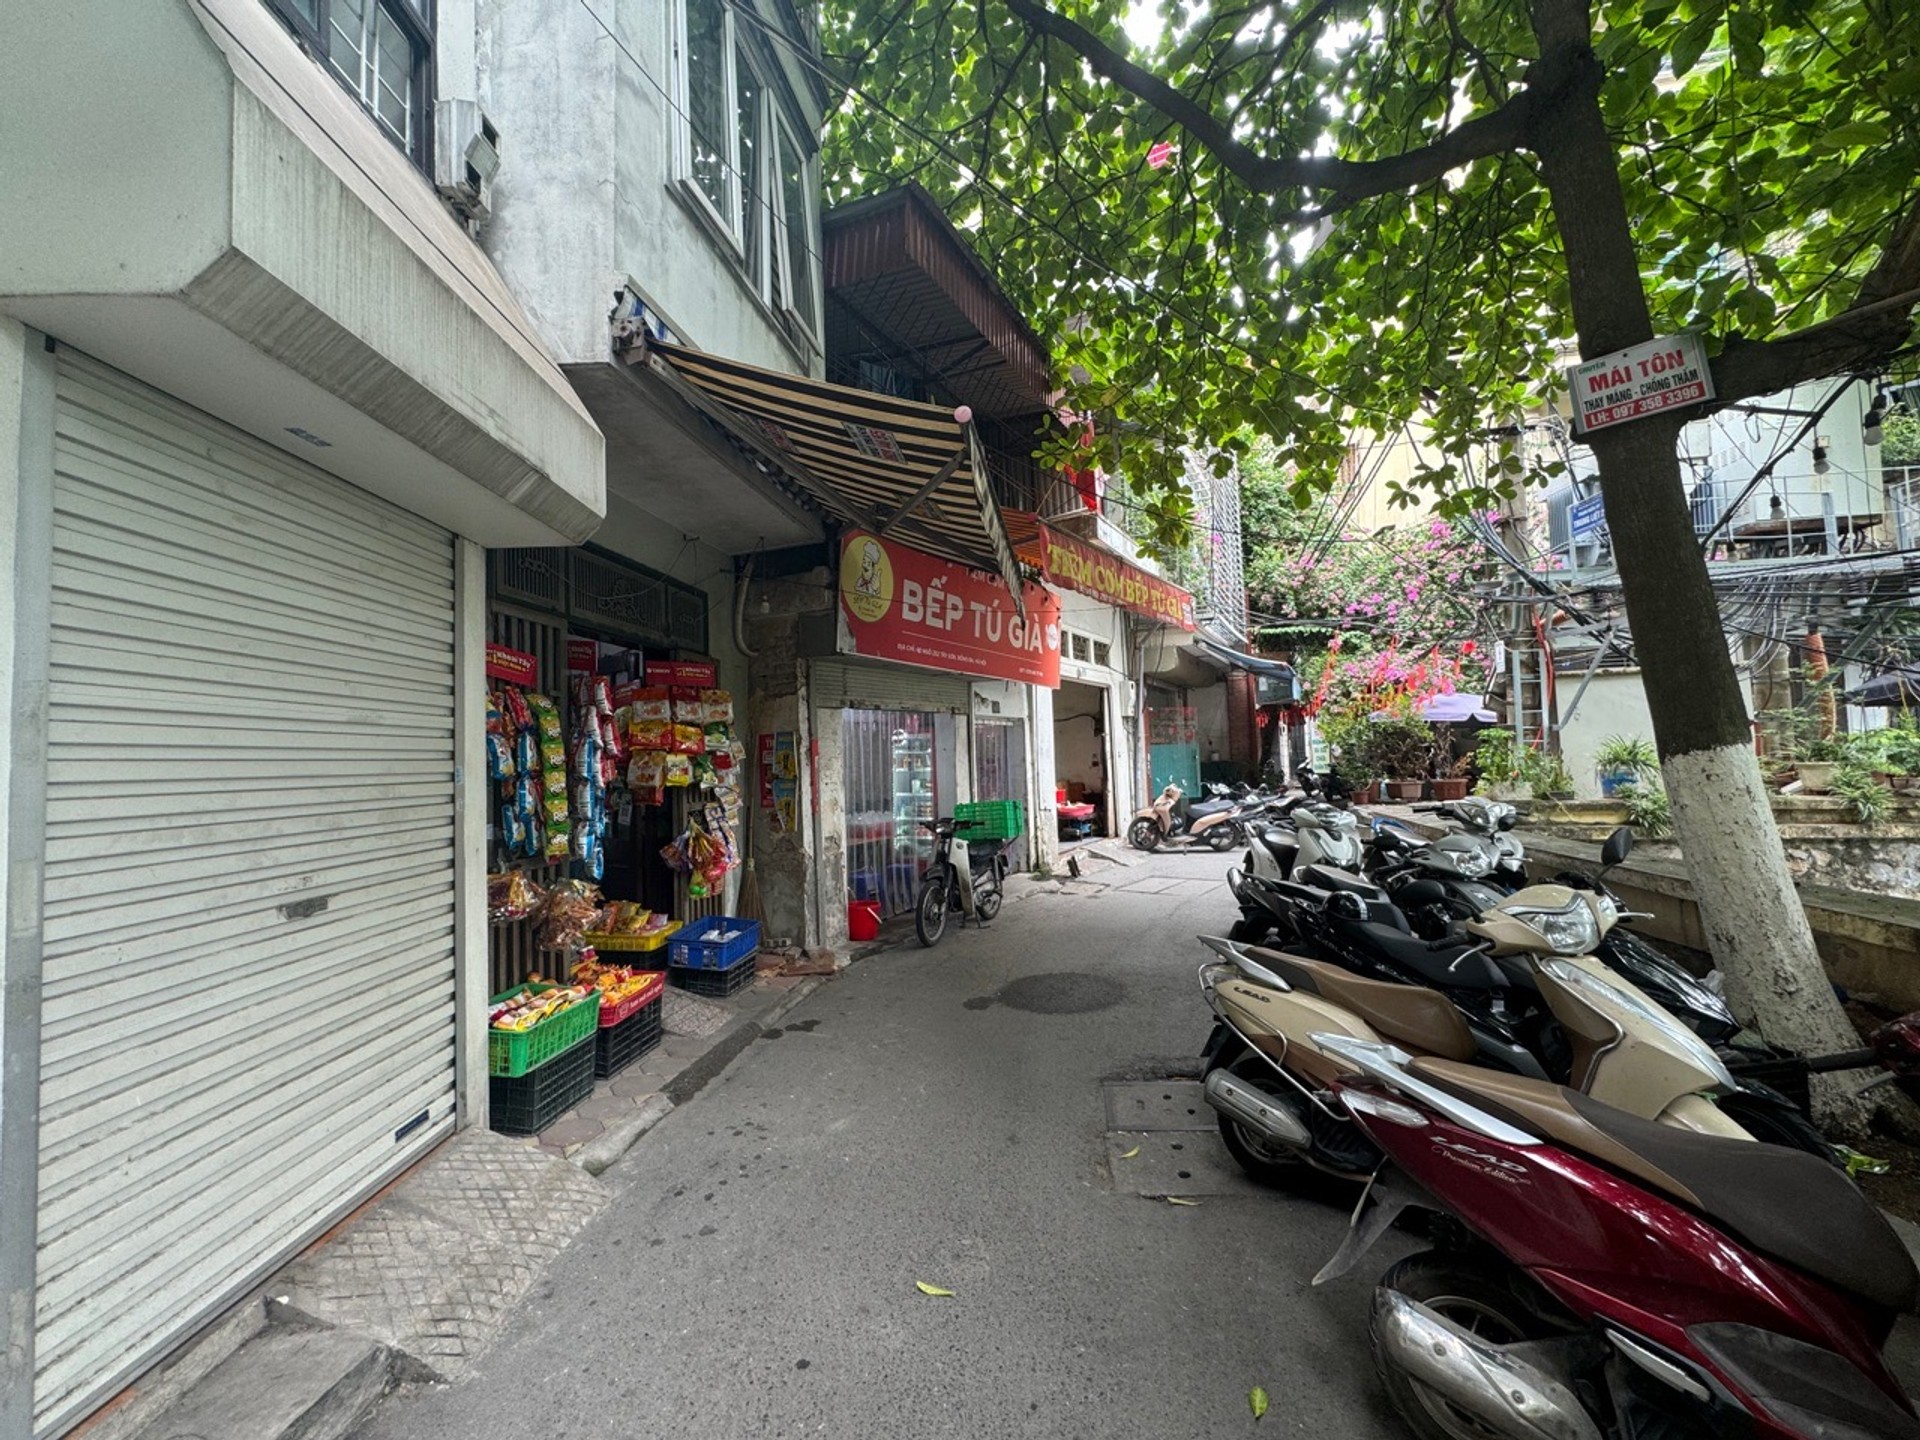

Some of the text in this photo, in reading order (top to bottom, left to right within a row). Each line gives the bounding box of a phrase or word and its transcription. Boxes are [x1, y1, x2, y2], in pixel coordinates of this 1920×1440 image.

[1584, 396, 1605, 412] THAY
[1606, 388, 1633, 406] MÁNG
[1639, 376, 1671, 396] CHỐNG
[1672, 367, 1699, 386] THẤM
[1588, 349, 1685, 393] MÁI TÔN
[1590, 385, 1699, 425] LH: 097 358 3396
[902, 575, 964, 631] BẾP
[970, 599, 1002, 643] TÚ
[1008, 613, 1043, 654] GIÀ
[1233, 986, 1271, 1004] LEAD
[1429, 1136, 1529, 1173] LEAD
